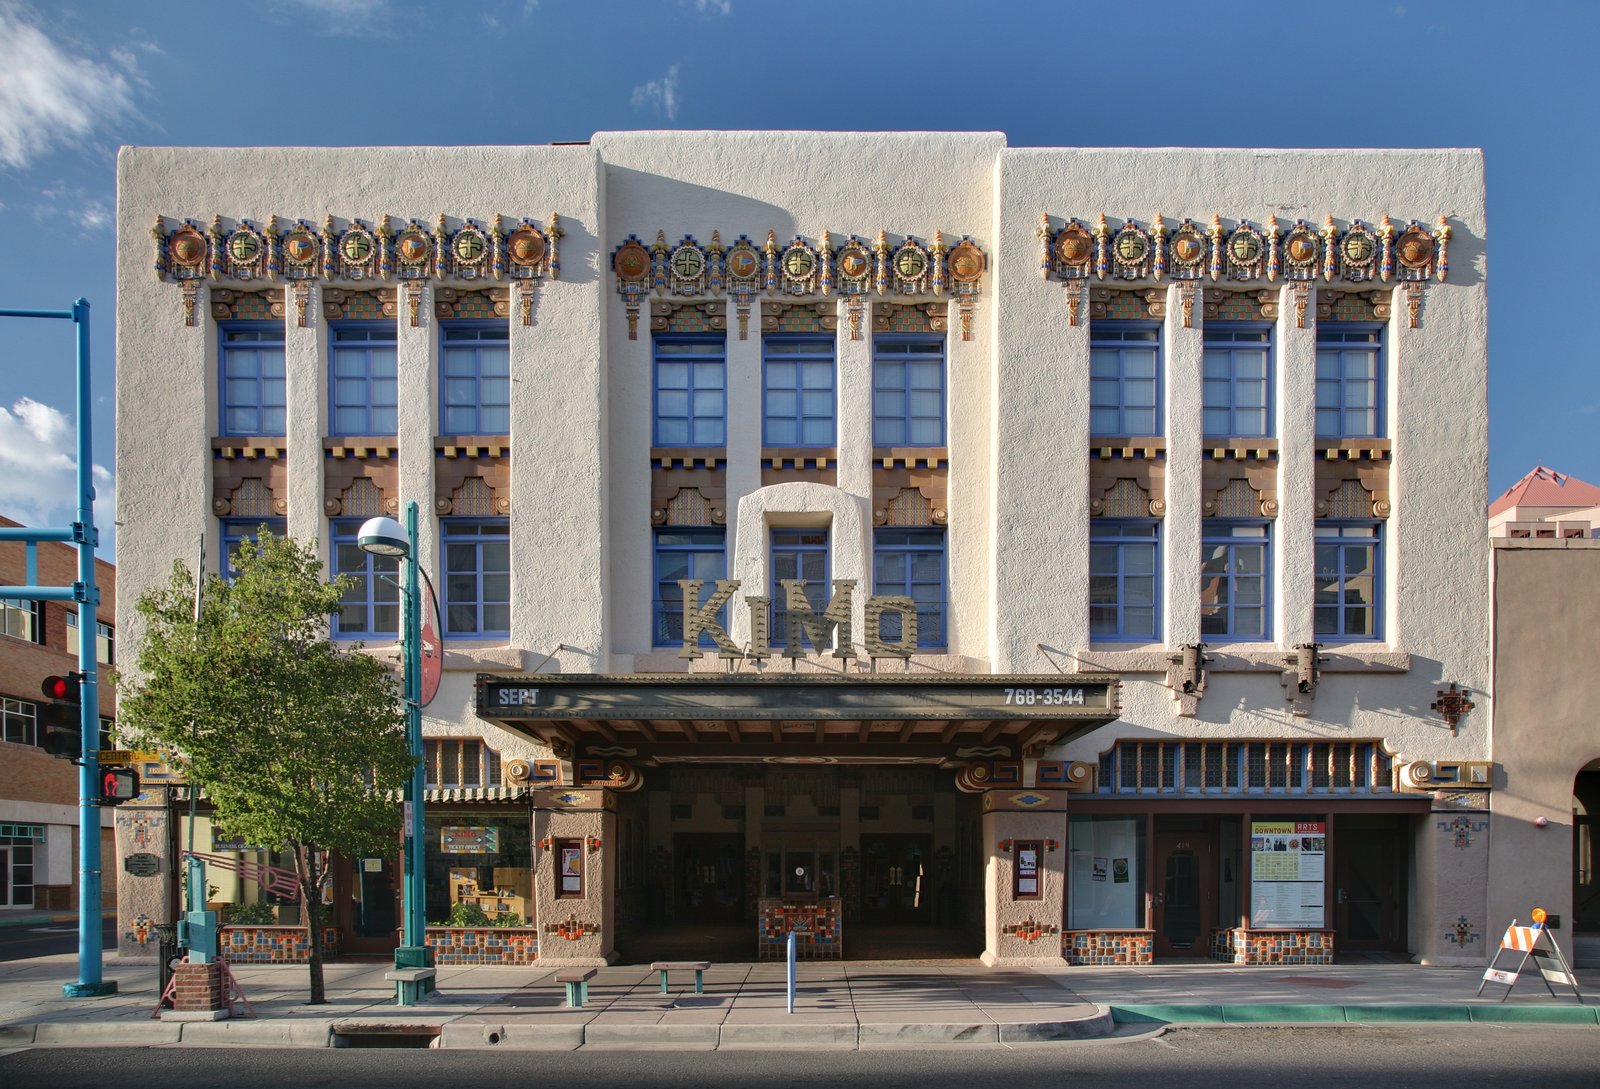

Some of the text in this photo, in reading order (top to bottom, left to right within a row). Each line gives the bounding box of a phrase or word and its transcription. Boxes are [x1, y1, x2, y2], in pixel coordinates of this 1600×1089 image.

[499, 689, 539, 704] SEPT
[1004, 688, 1084, 705] 768-3544
[100, 751, 139, 760] CENTRAL
